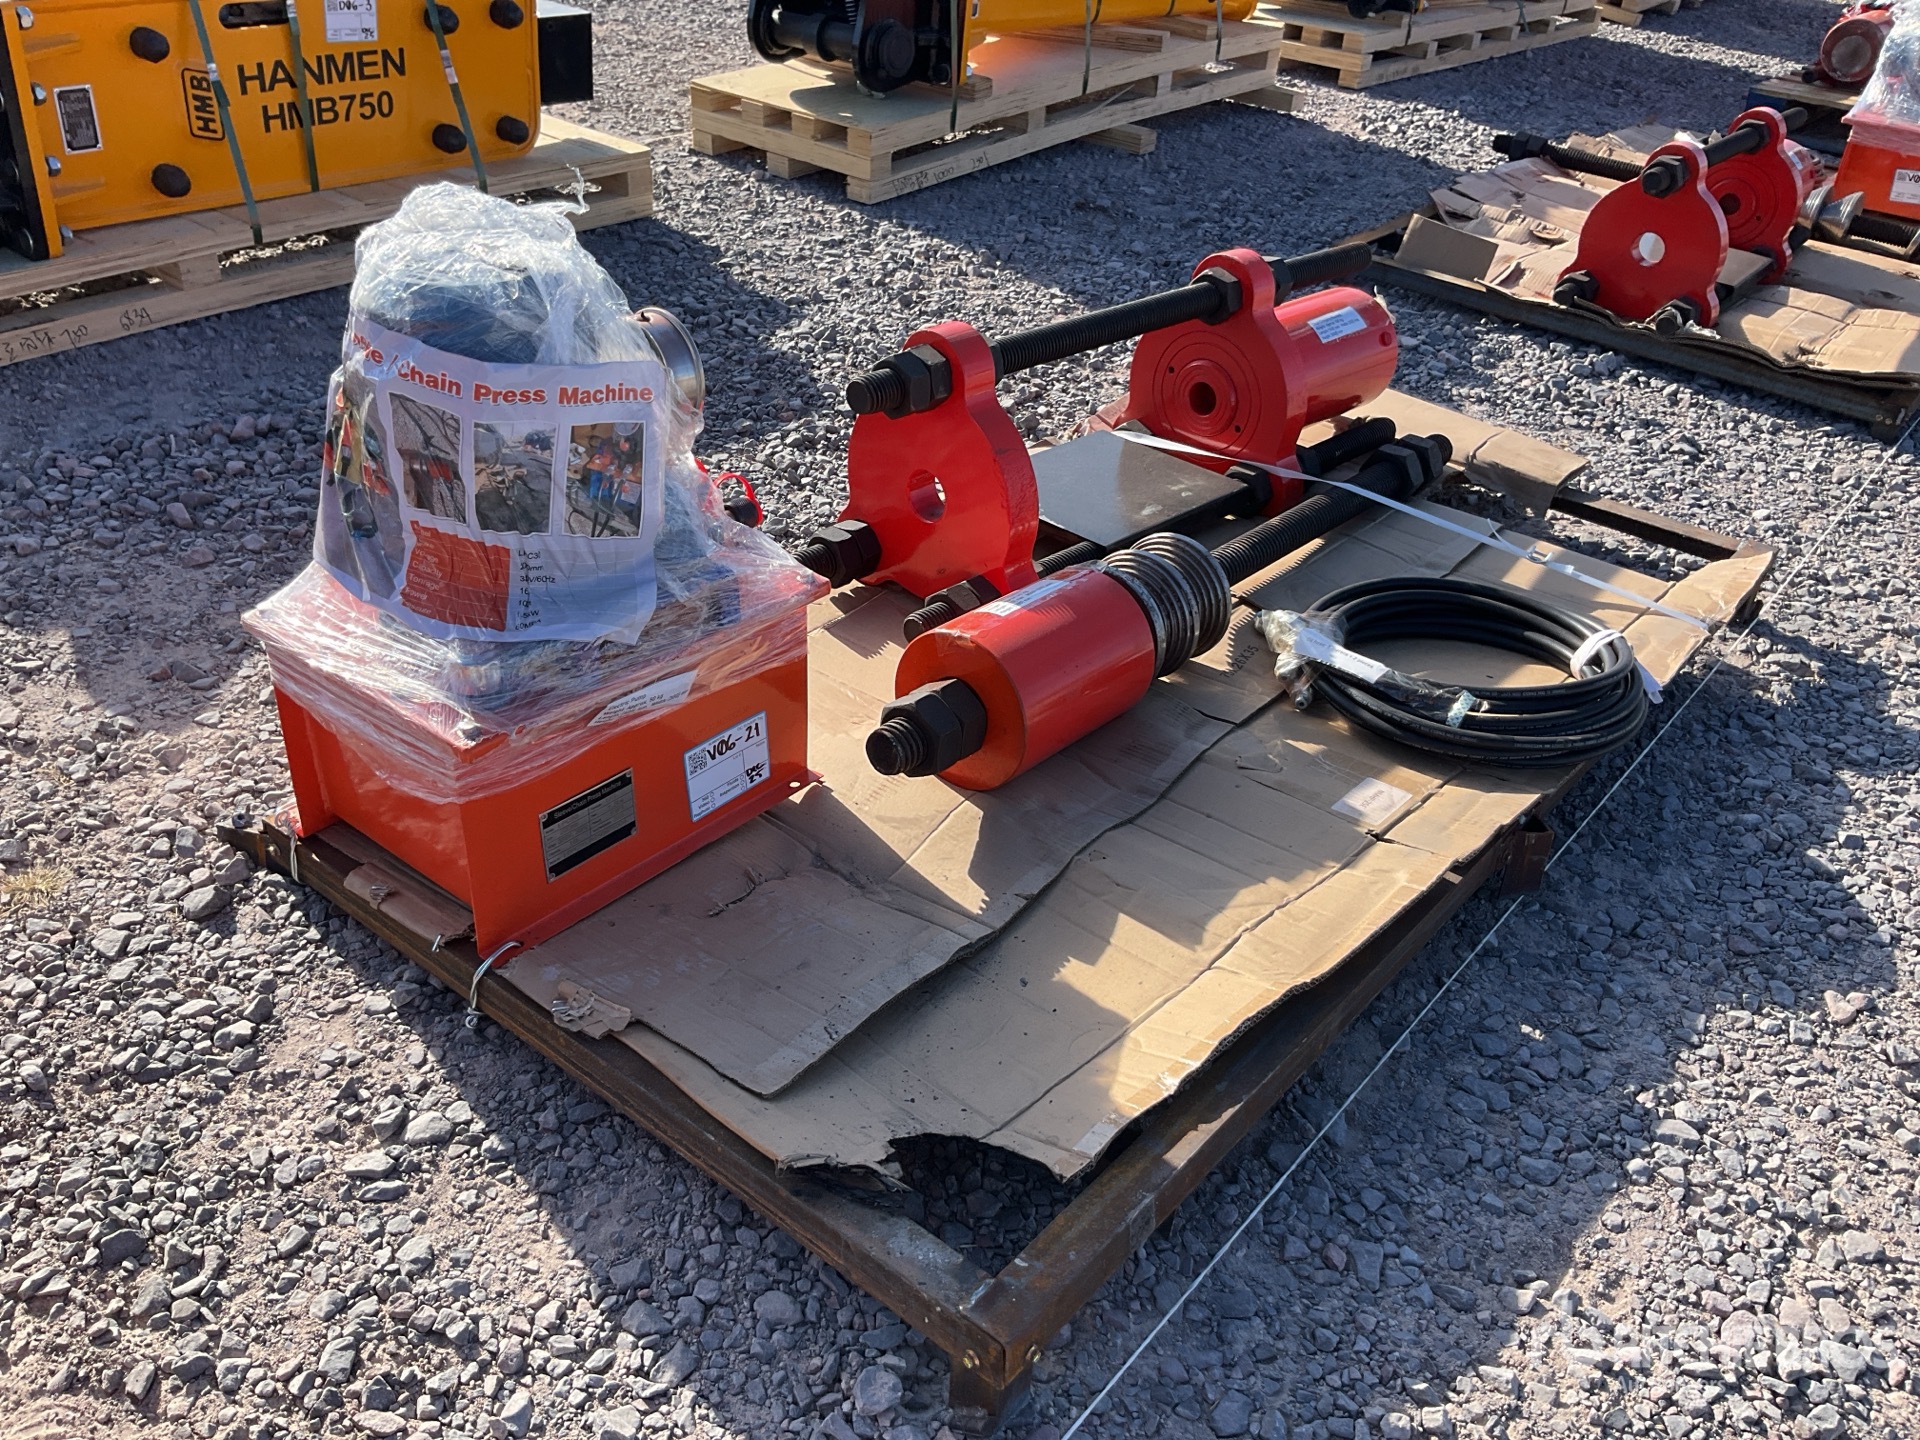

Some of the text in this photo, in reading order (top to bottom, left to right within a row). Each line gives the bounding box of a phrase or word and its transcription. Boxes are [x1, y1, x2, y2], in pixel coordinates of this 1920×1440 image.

[236, 47, 406, 96] HANMEN
[189, 74, 219, 134] HMB
[261, 90, 394, 134] HMB750
[398, 358, 463, 398] Chain
[473, 383, 546, 404] Press
[558, 382, 653, 405] Machine
[587, 791, 602, 803] Press
[601, 781, 622, 795] Machine
[748, 767, 765, 784] 25
